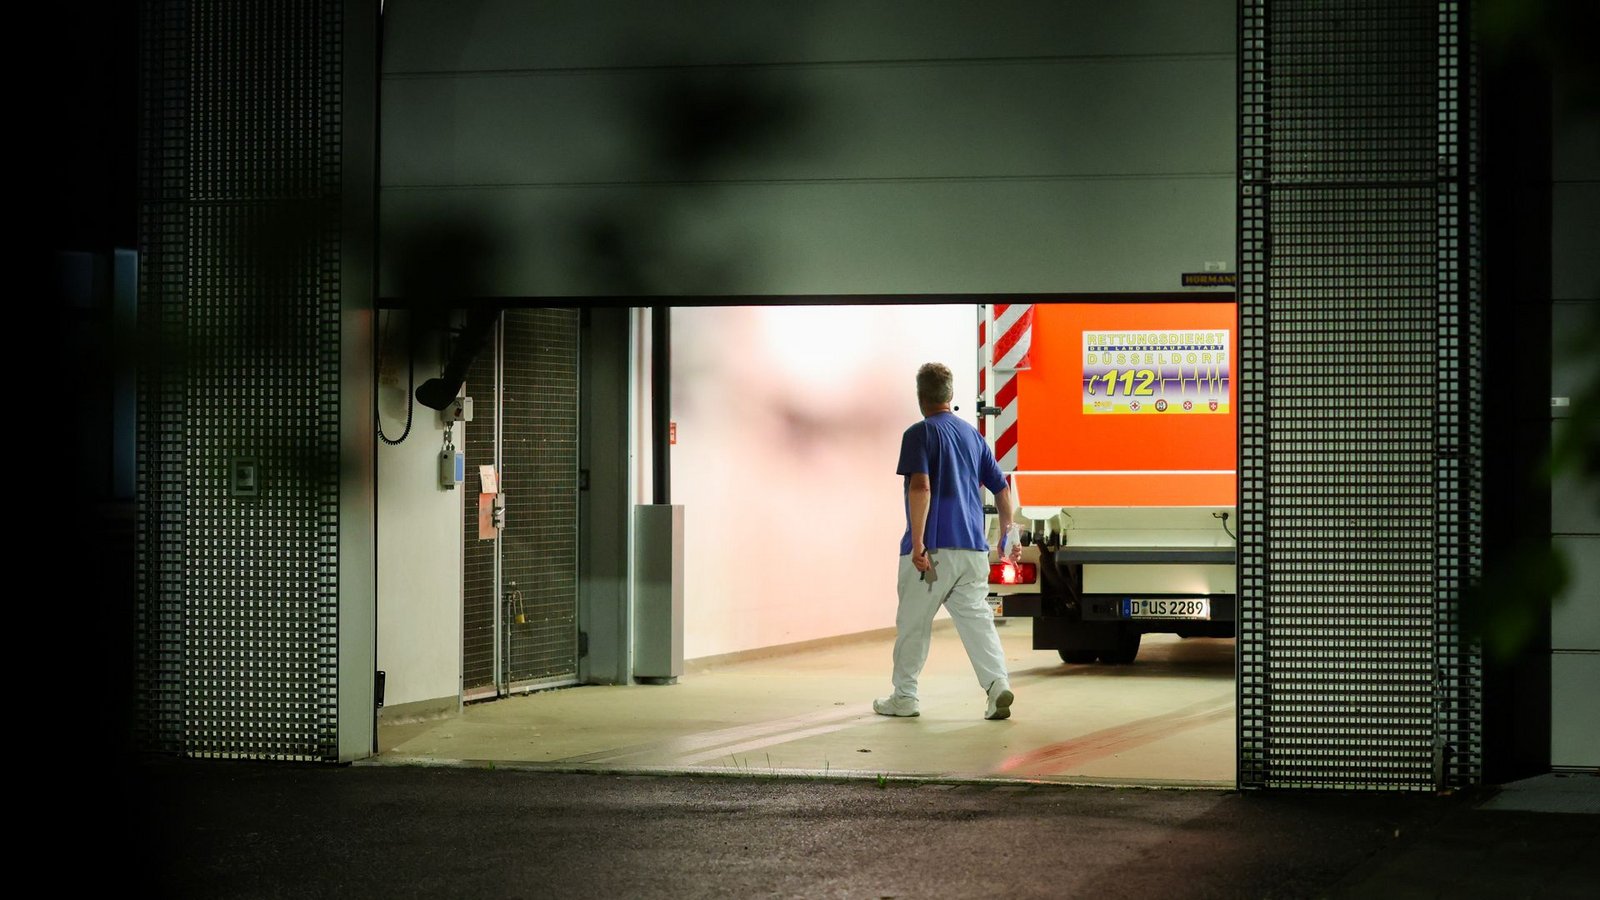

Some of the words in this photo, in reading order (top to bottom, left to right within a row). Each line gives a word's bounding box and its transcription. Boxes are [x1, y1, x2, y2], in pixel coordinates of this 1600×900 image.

[1087, 333, 1225, 345] RETTUNGSDIENST
[1087, 352, 1225, 365] DÜSSELDORF
[1102, 369, 1155, 396] 112
[1131, 601, 1140, 615] D
[1149, 601, 1167, 615] US
[1169, 601, 1204, 615] 2289
